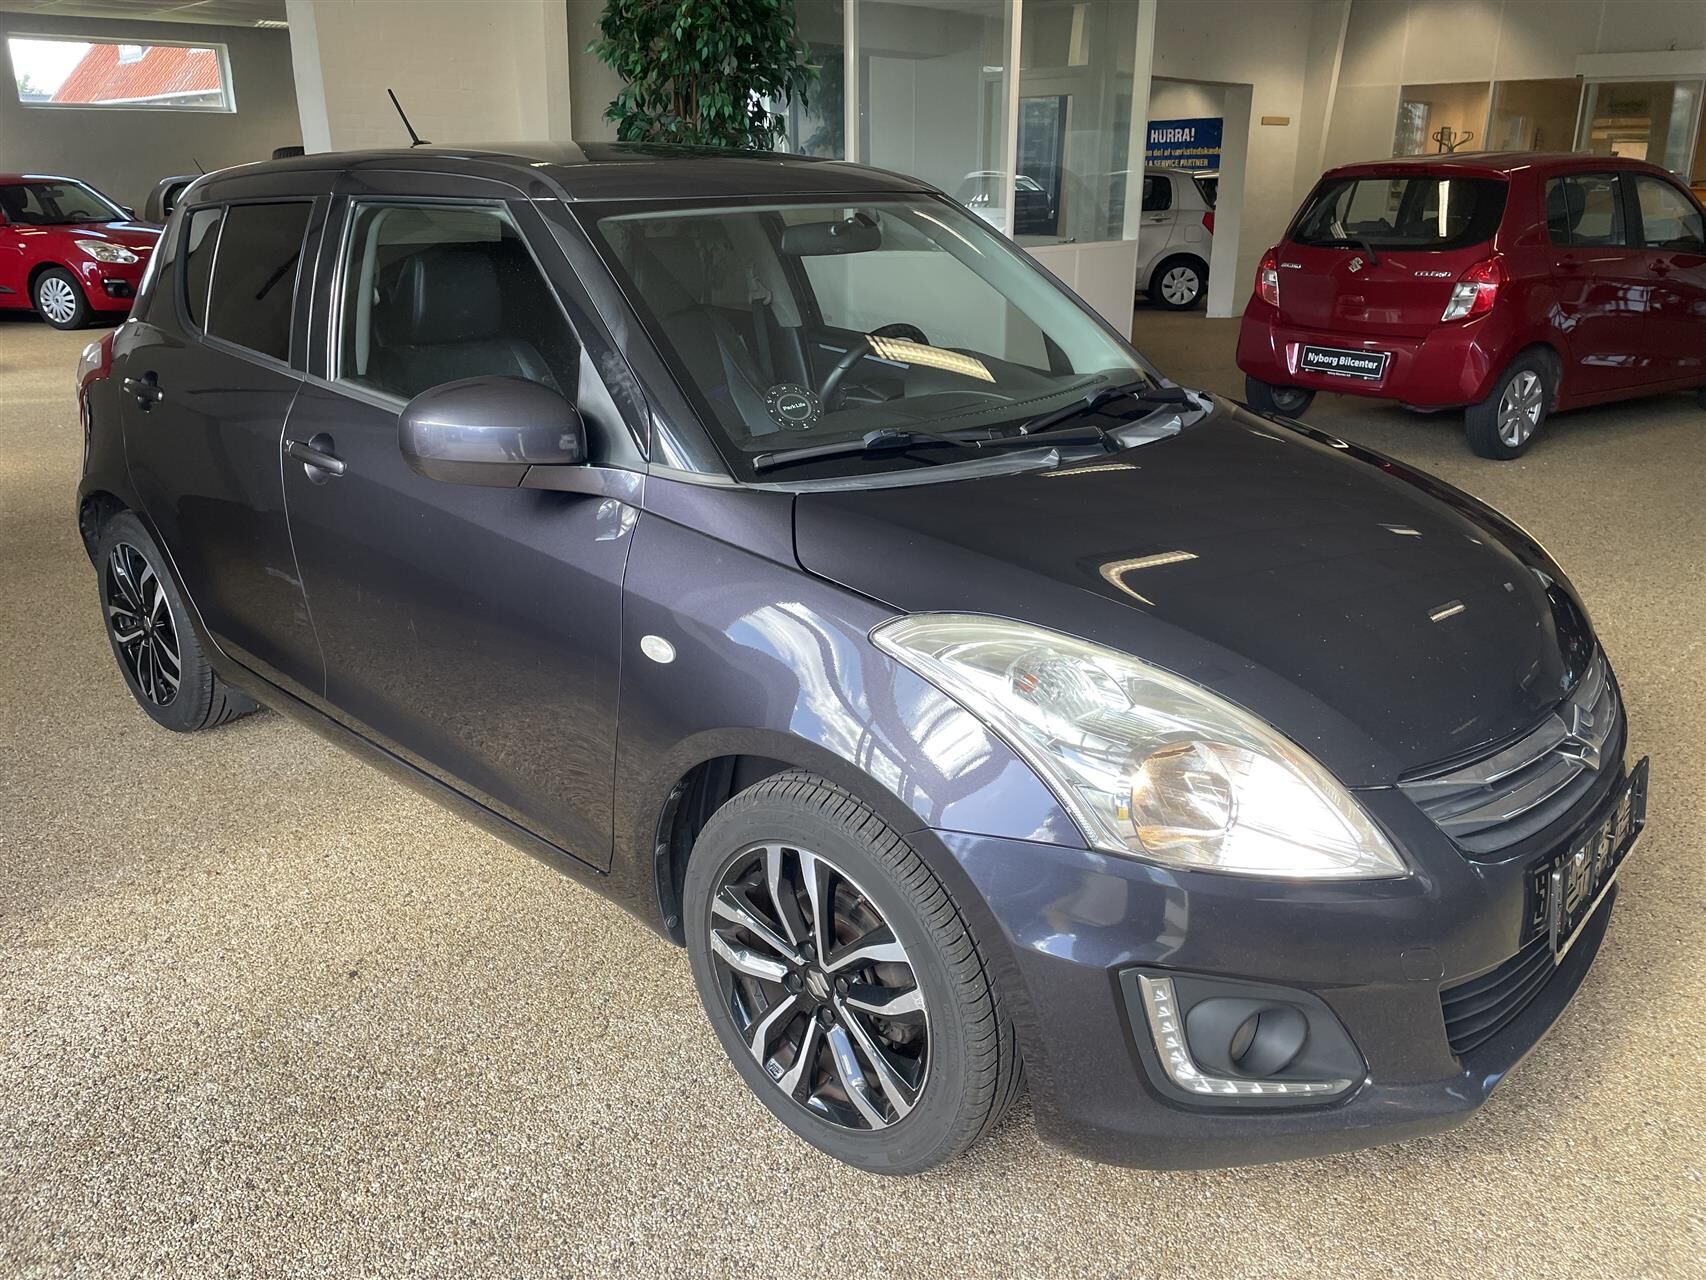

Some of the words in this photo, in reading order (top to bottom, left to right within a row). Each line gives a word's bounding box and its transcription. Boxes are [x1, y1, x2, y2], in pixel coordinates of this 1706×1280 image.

[1150, 128, 1195, 143] HURRA!
[1307, 352, 1338, 366] Nyborg
[1339, 356, 1378, 369] Bilcenter
